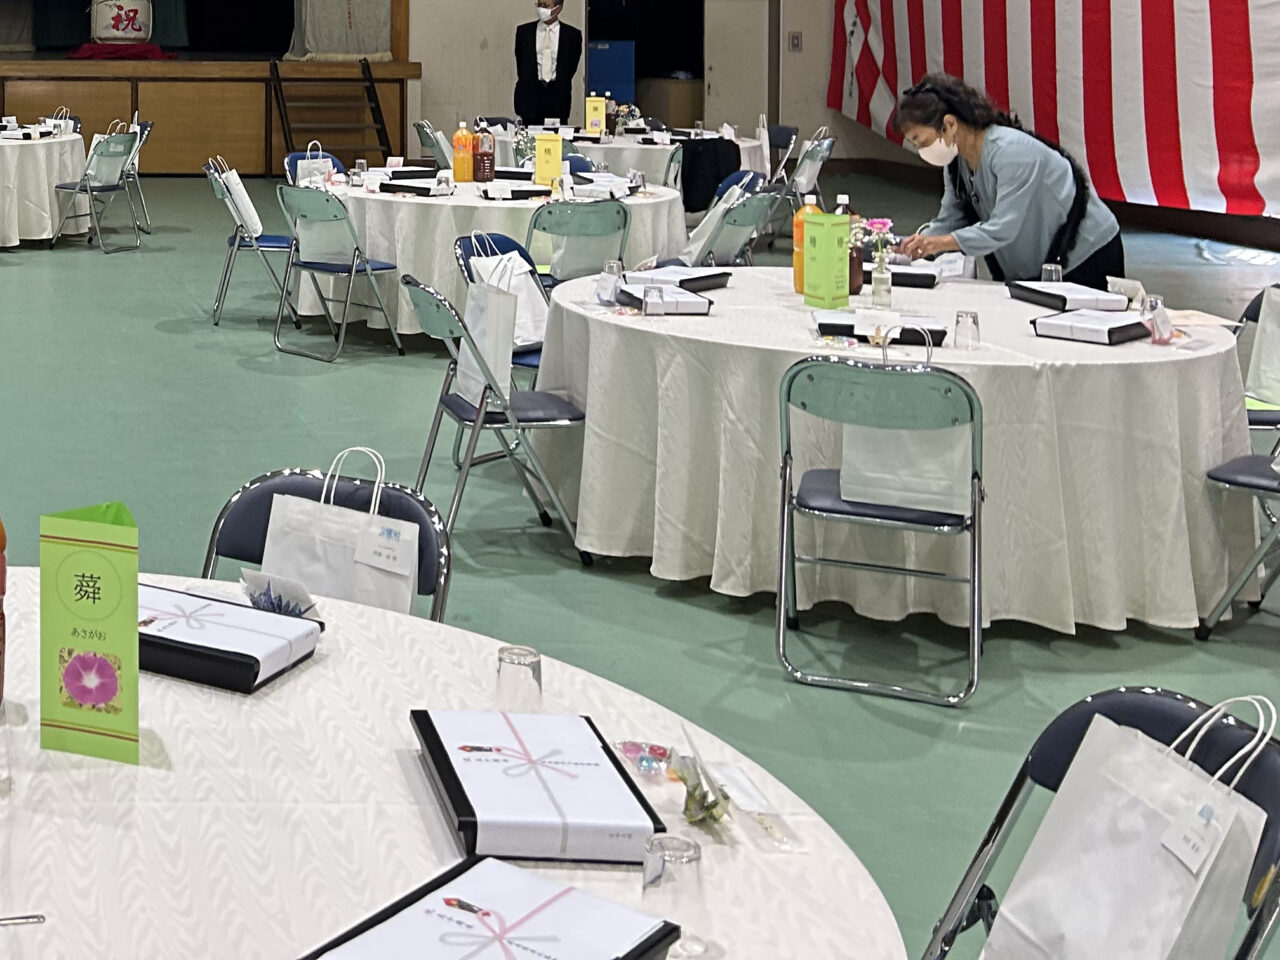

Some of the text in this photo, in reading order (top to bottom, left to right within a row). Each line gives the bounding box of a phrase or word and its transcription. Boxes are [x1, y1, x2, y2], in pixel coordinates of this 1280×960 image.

[110, 4, 144, 33] 祝
[73, 573, 102, 605] 蕣
[70, 627, 107, 641] あさがお
